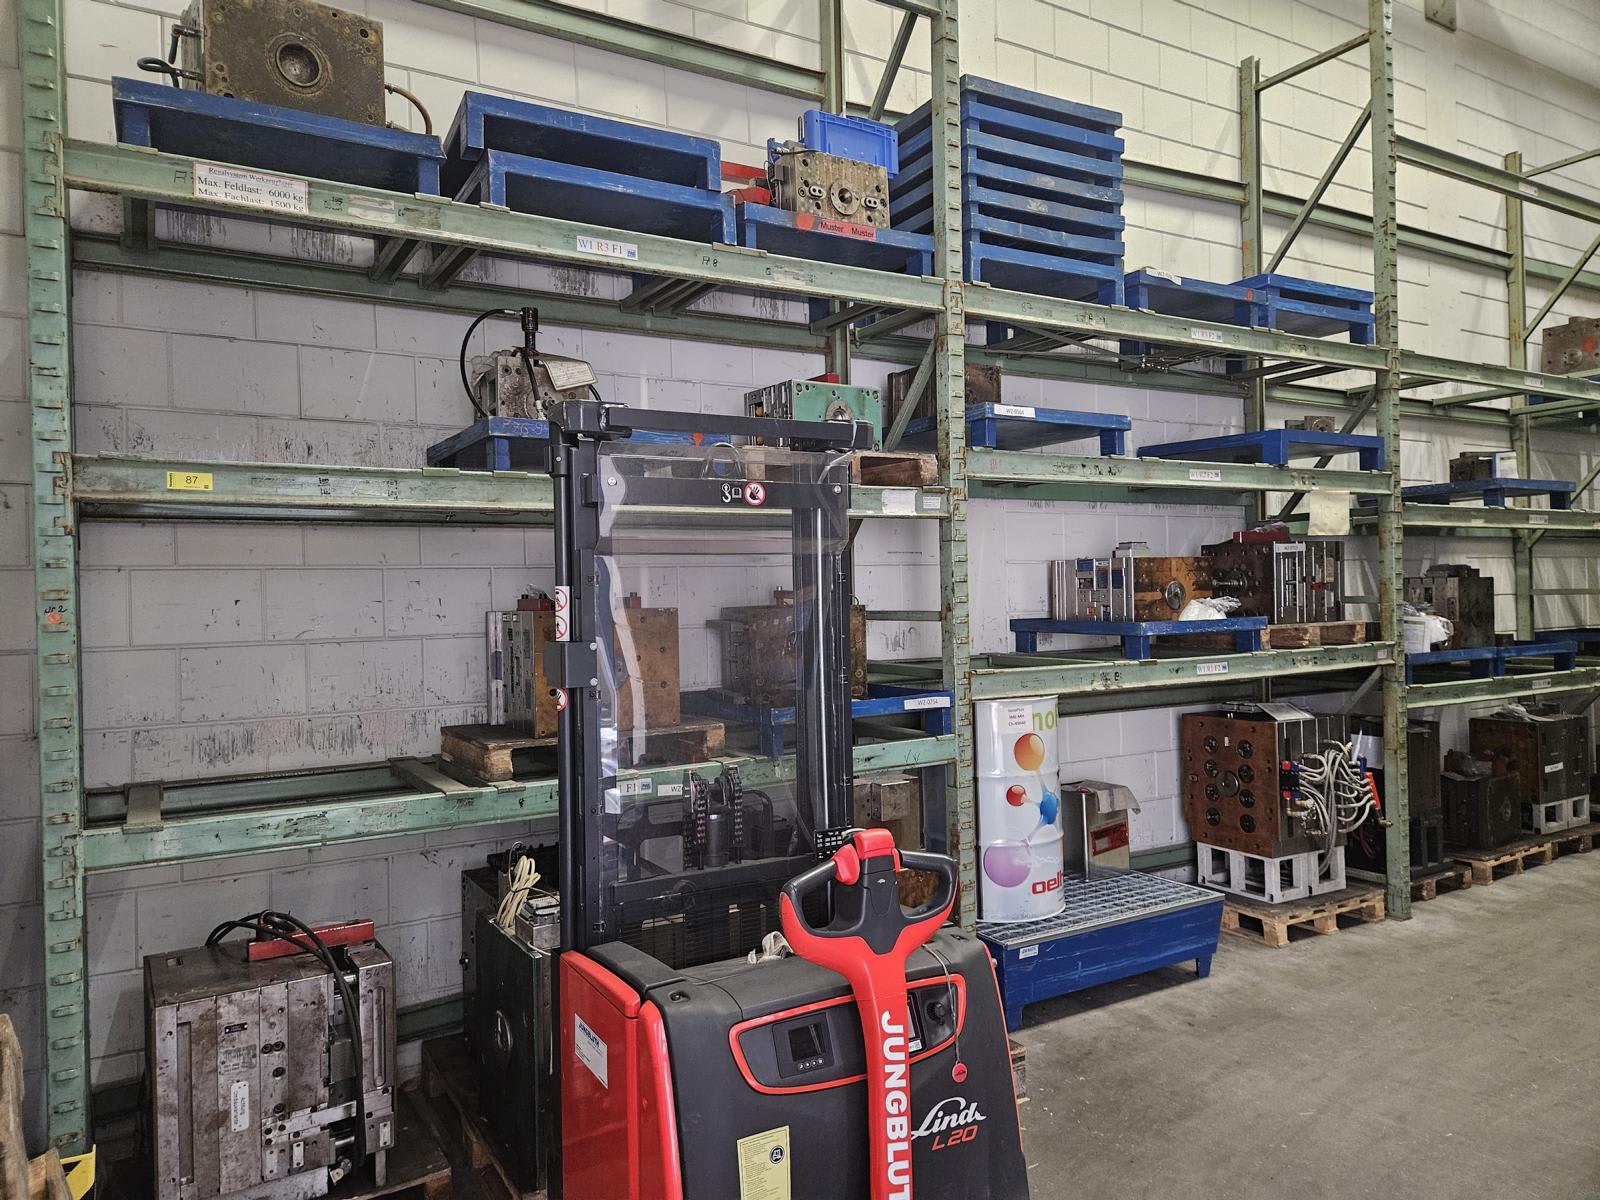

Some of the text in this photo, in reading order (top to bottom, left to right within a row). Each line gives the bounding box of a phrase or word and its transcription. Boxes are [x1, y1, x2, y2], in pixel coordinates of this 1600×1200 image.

[198, 177, 304, 203] Max. Feldlast: 6000 kg
[198, 188, 304, 212] Max. Fachlast: 1500 kg
[821, 221, 875, 238] Muster Muster
[578, 239, 593, 250] W1
[597, 241, 609, 252] R3
[185, 475, 198, 484] 87
